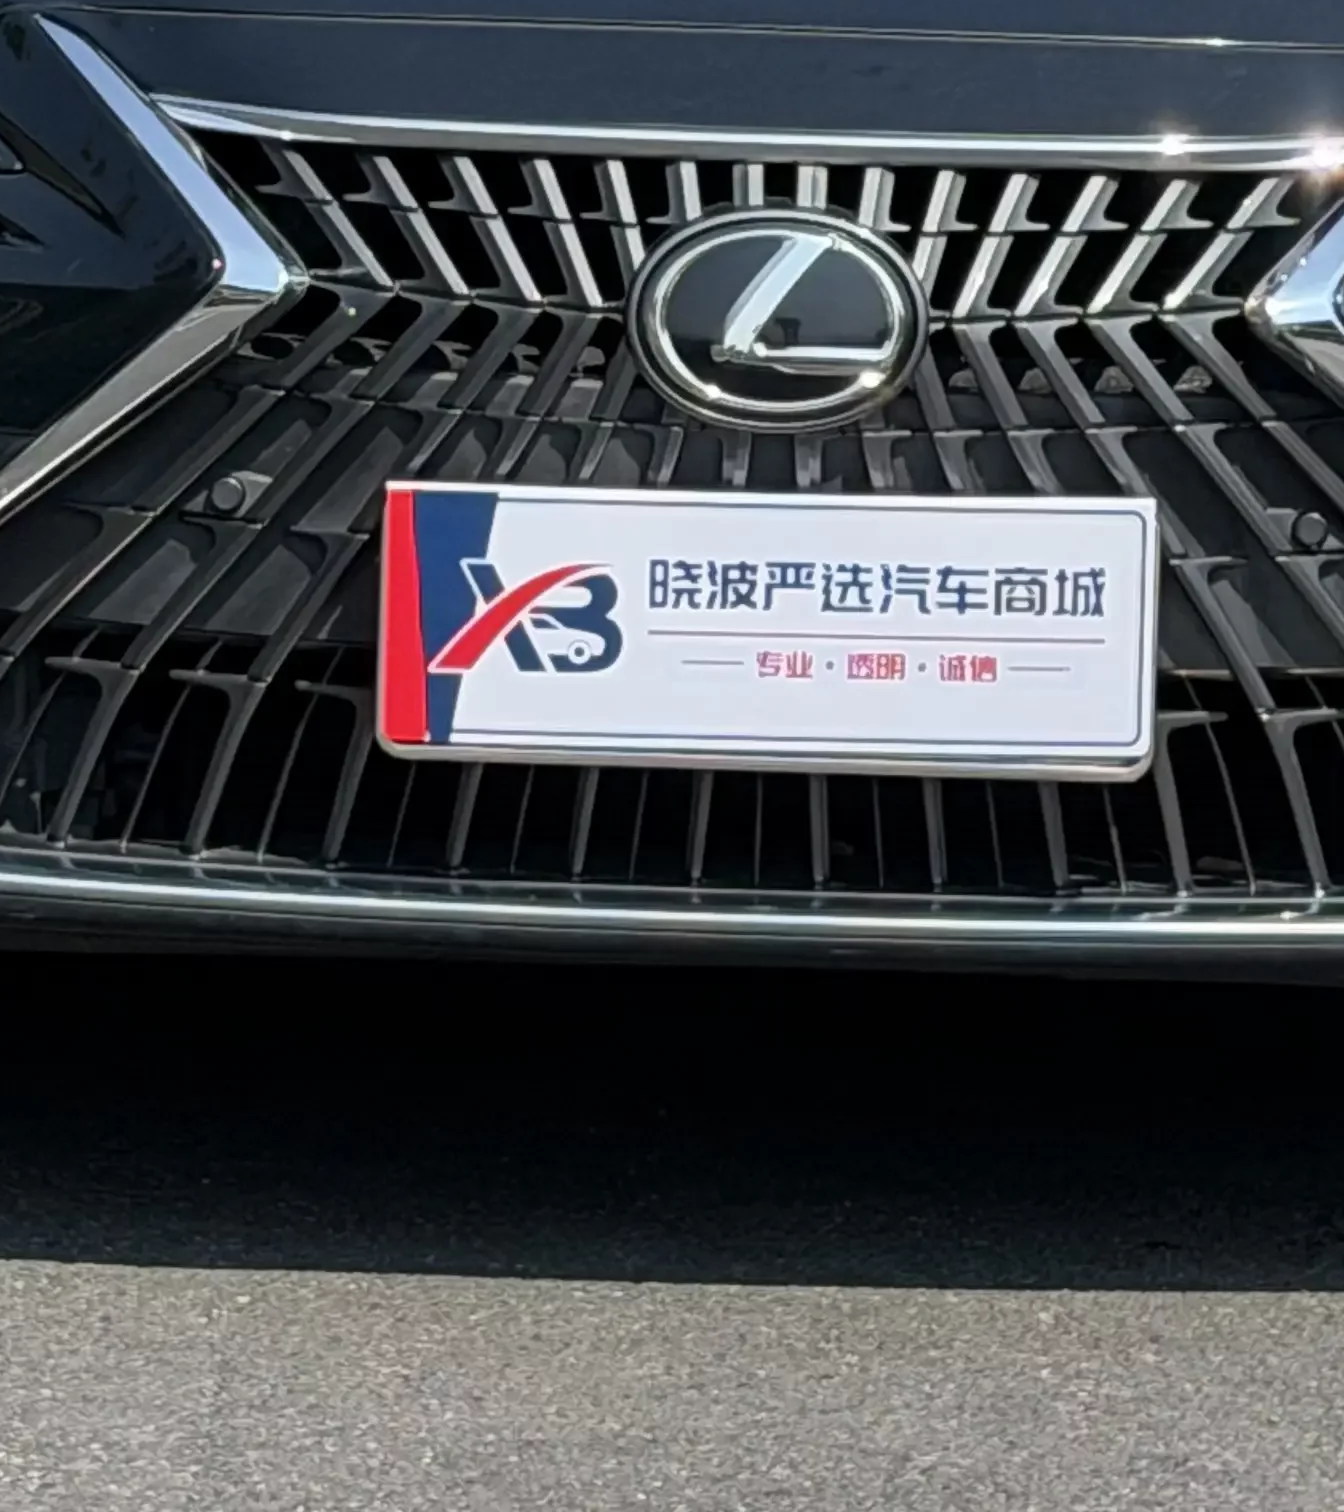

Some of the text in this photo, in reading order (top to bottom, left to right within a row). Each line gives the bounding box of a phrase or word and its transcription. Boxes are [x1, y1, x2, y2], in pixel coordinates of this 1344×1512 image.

[648, 559, 1106, 617] 晓波严选汽车商城
